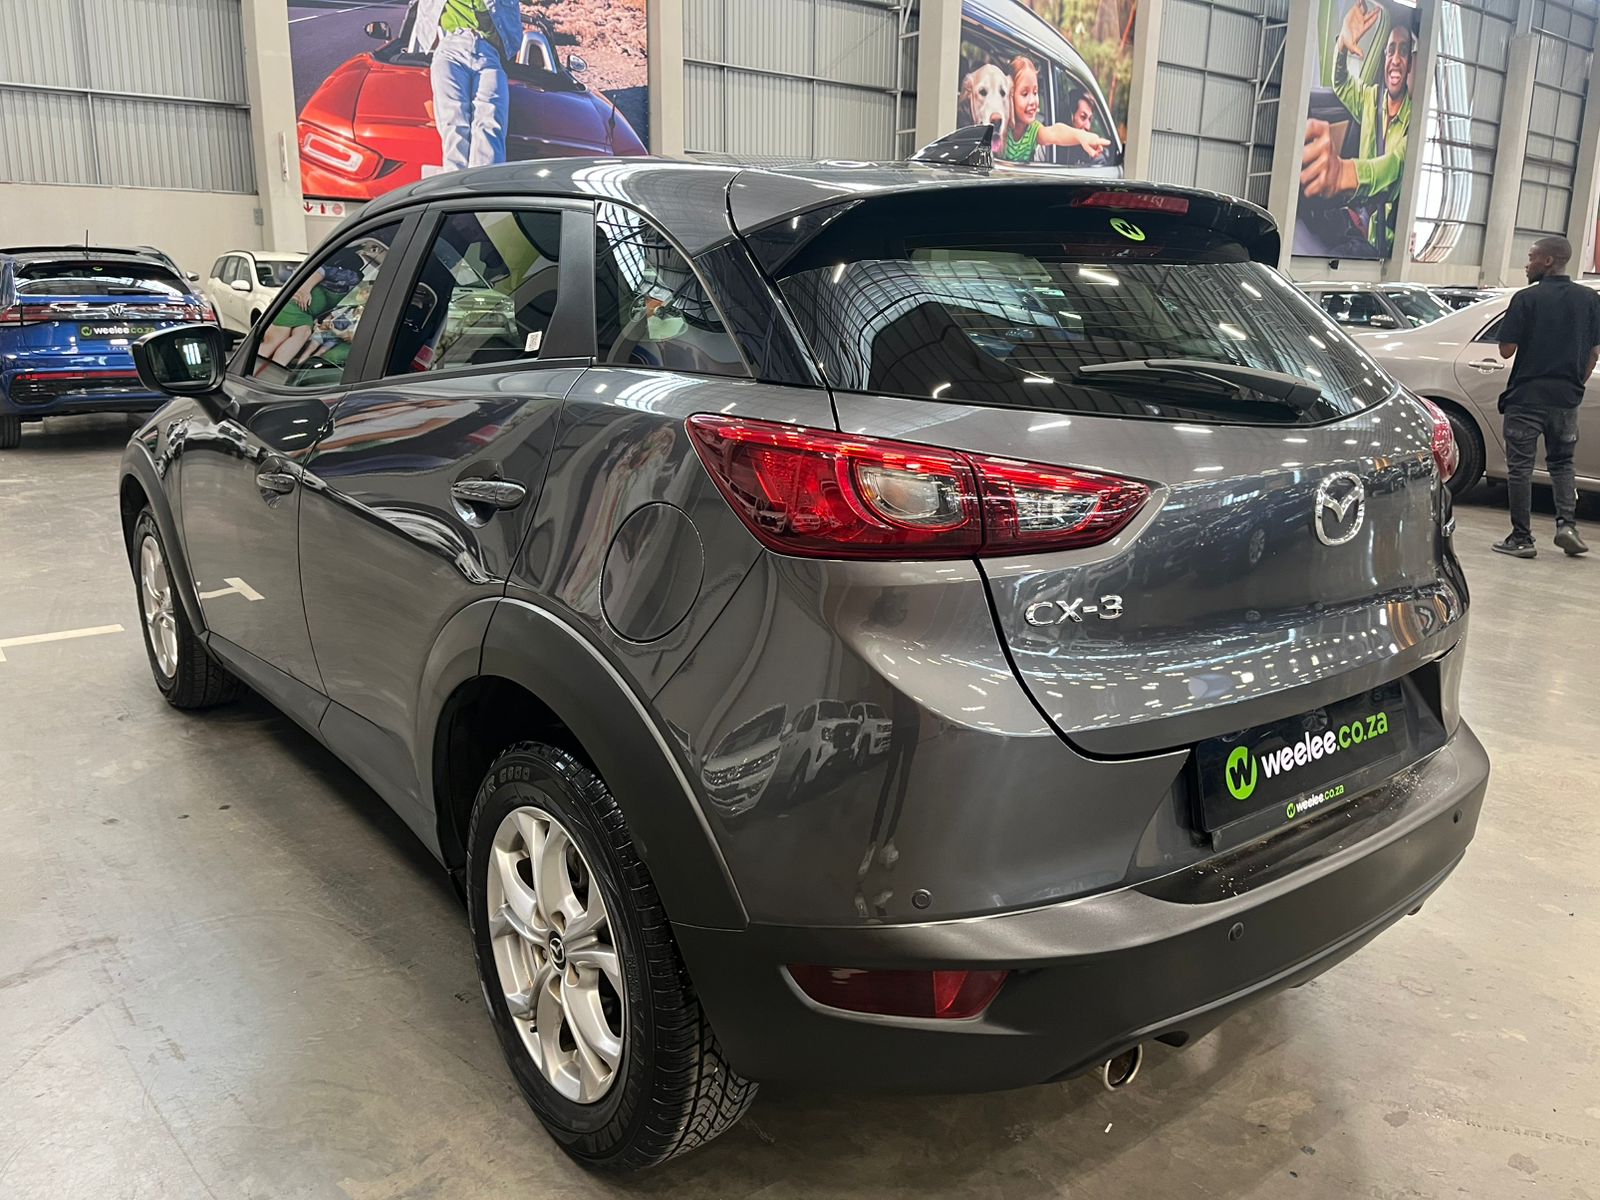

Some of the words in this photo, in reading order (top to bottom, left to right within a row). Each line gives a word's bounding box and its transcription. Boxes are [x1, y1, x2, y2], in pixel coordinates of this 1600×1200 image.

[1024, 594, 1123, 627] CX-3
[1261, 711, 1389, 779] weelee.co.za
[1296, 784, 1345, 813] weelee.co.za
